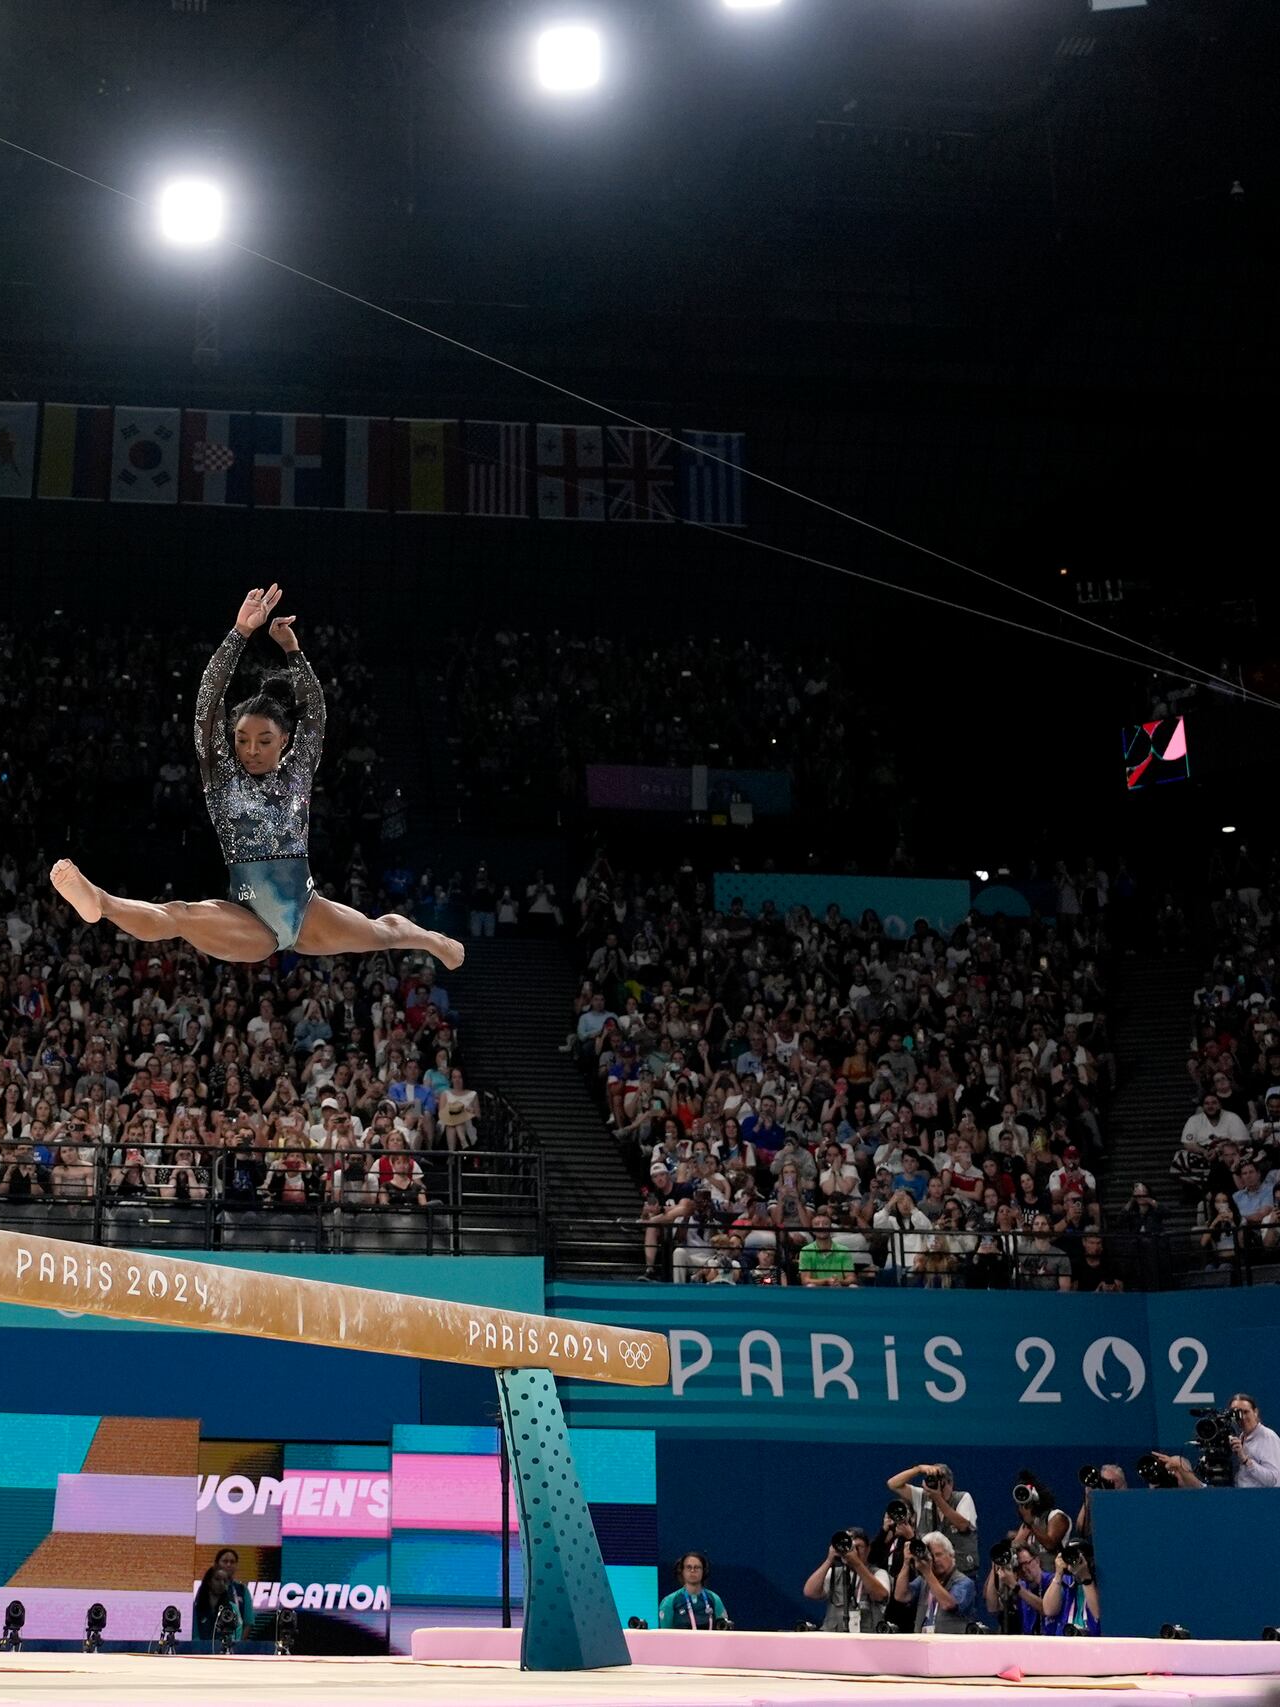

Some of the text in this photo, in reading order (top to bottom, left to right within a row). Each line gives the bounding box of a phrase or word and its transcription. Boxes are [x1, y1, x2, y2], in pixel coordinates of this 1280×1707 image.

[238, 890, 256, 901] USA
[126, 1265, 208, 1306] 2024
[548, 1331, 608, 1363] 2024
